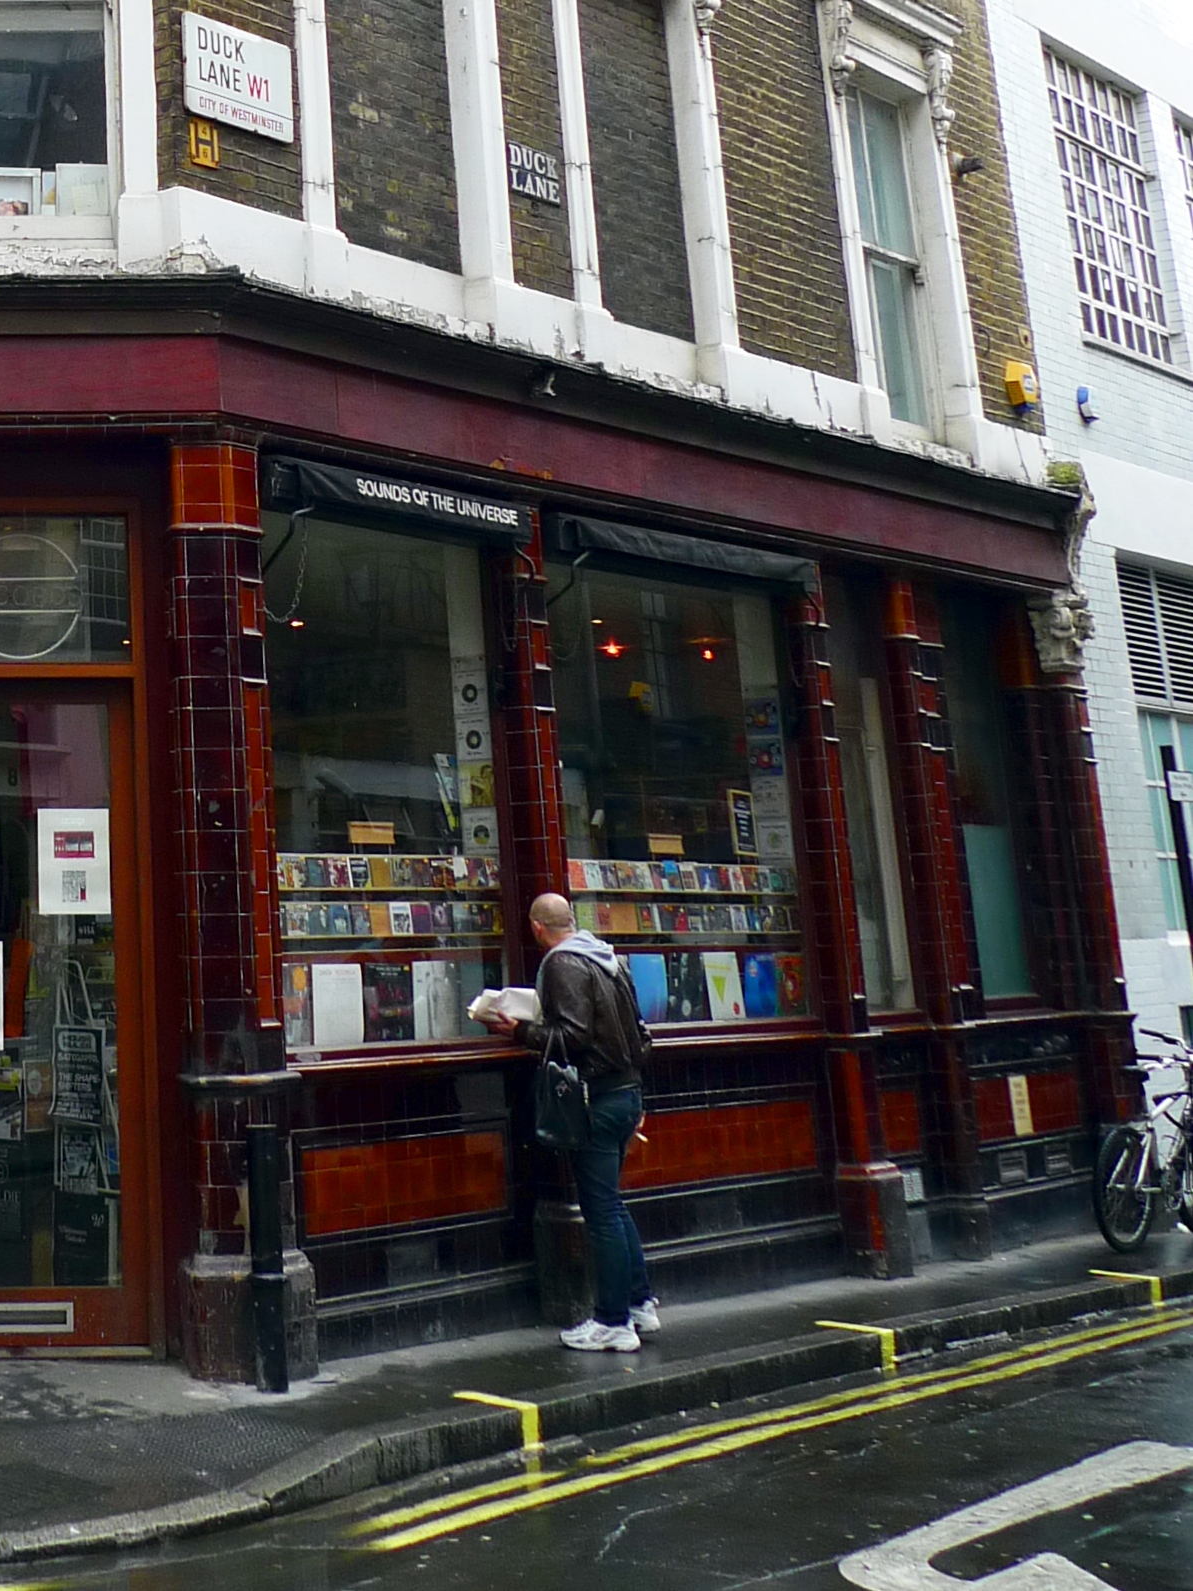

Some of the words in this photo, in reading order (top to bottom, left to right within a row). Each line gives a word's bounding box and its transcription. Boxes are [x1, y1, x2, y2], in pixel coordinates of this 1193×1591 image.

[197, 26, 246, 64] DUCK
[198, 56, 242, 93] LANE
[247, 72, 270, 102] W1
[199, 96, 216, 112] CITY
[219, 102, 229, 115] OF
[231, 106, 284, 134] WESTMINSTER
[509, 143, 559, 180] DUCK
[510, 167, 561, 204] LANE
[356, 478, 411, 504] SOUNDS
[412, 488, 430, 507] OF
[430, 493, 456, 514] THE
[456, 498, 519, 526] UNIVERSE
